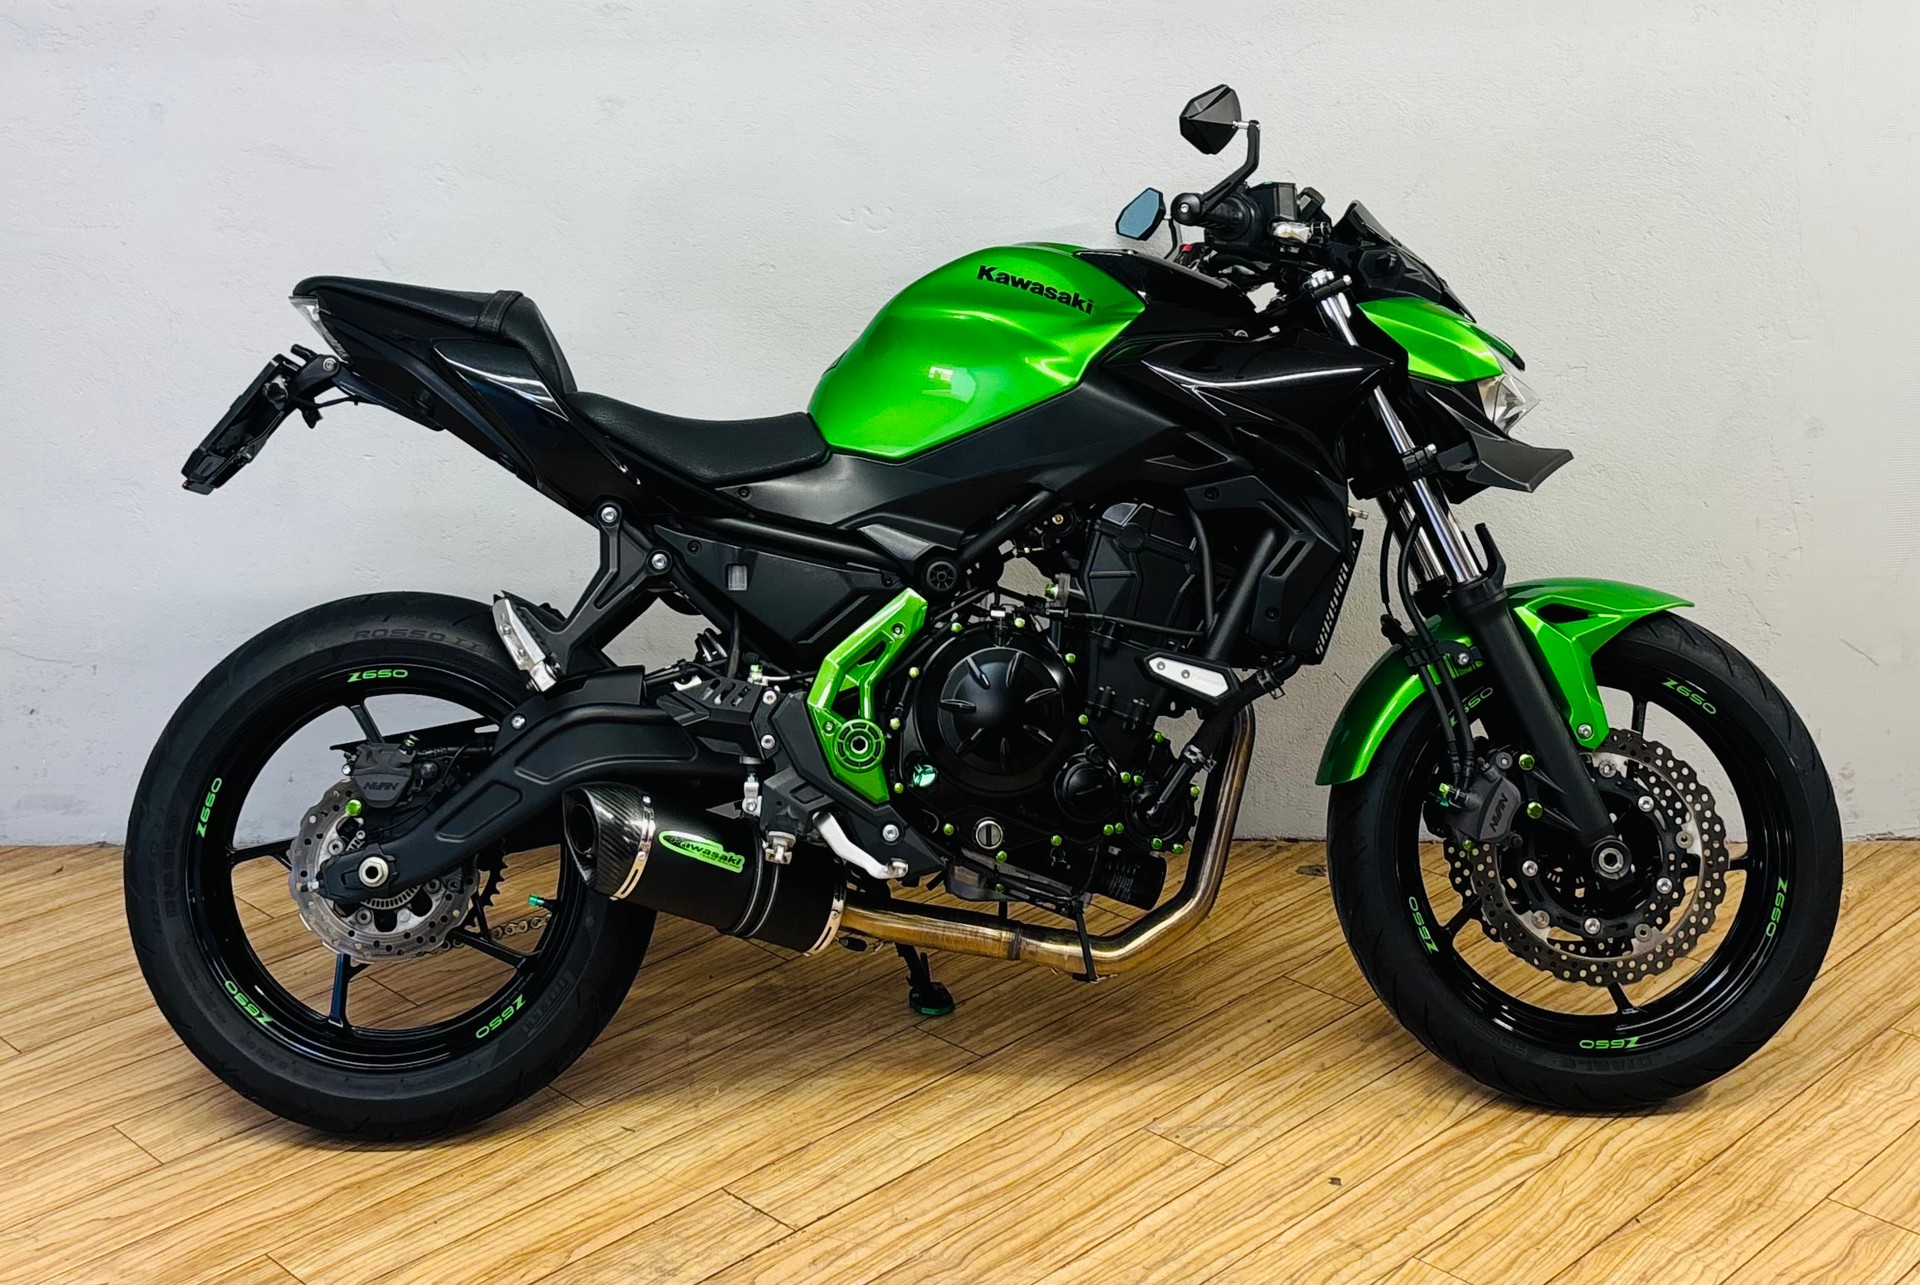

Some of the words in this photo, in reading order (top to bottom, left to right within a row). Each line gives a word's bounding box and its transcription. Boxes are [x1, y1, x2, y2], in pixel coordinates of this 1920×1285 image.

[977, 264, 1094, 315] Kawasaki
[354, 628, 446, 641] ROSSO
[347, 668, 409, 682] Z650
[1663, 679, 1717, 716] Z650
[196, 777, 223, 838] Z650
[669, 836, 742, 866] Kawasaki
[1408, 895, 1441, 954] Z650
[1765, 877, 1789, 938] Z650
[224, 978, 273, 1026] Z650
[475, 993, 527, 1039] Z650
[1578, 1035, 1641, 1050] Z650
